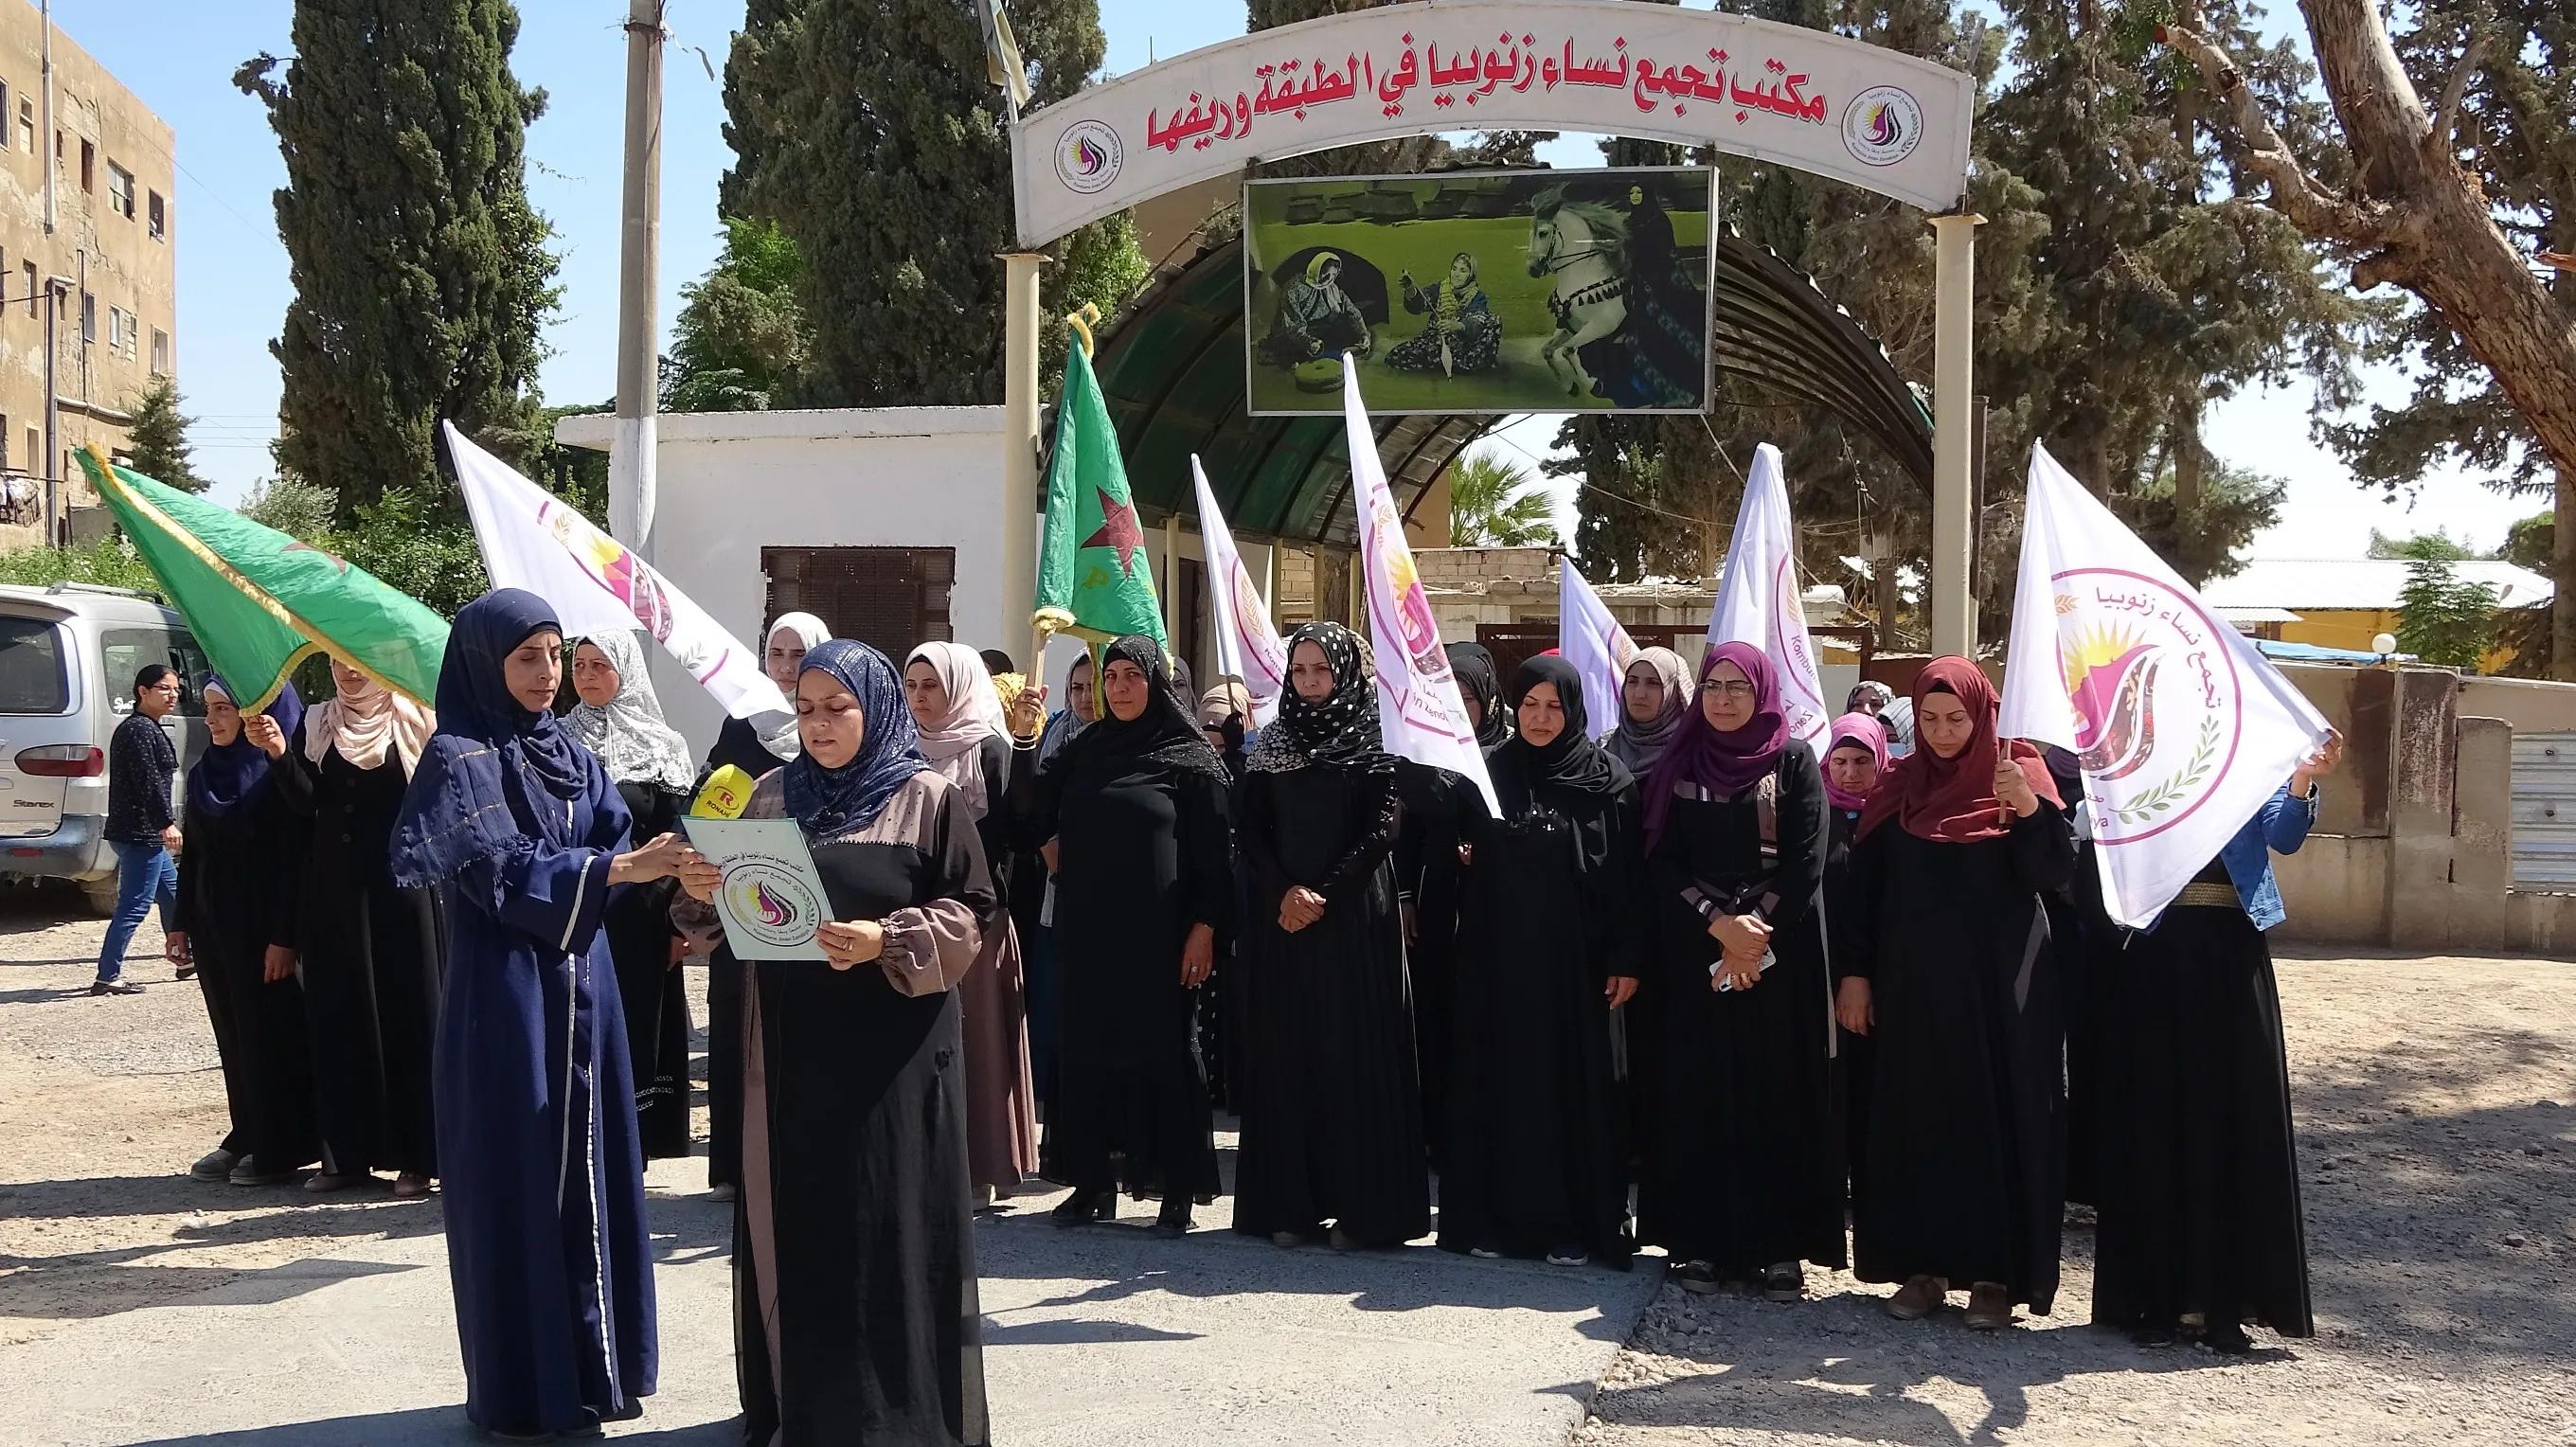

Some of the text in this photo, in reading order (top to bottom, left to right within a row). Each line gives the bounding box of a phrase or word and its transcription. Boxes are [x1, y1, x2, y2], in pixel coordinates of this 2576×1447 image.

[1147, 33, 1827, 152] مكتب تجمع نساء زنوبيا في الطبقة وريفها
[2096, 585, 2221, 709] تجمع نساء زنوبيا
[13, 799, 55, 808] Starex
